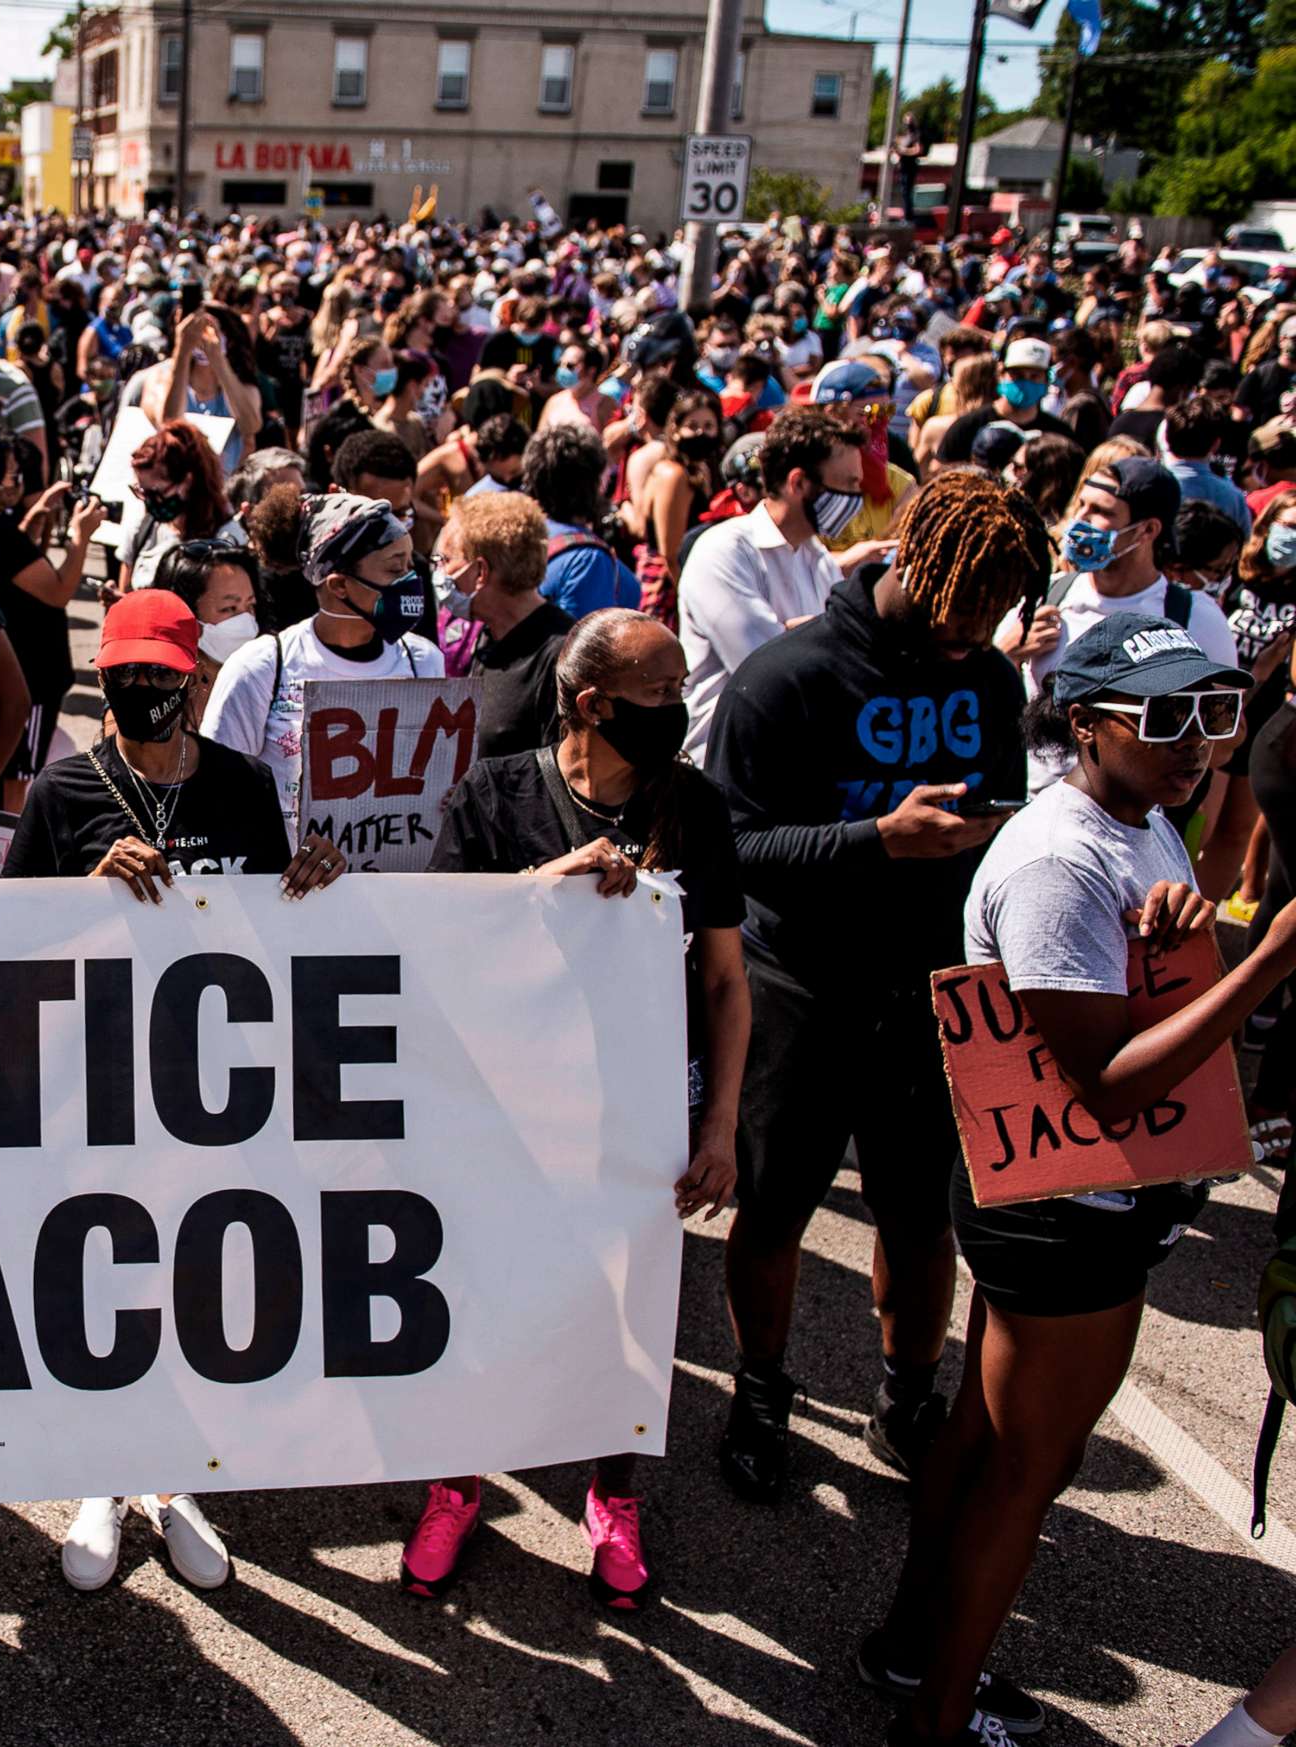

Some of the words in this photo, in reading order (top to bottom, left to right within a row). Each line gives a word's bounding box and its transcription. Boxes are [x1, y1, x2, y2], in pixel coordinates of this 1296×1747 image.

[216, 143, 246, 170] LA
[689, 142, 747, 159] SPEED
[694, 160, 738, 176] LIMIT
[689, 181, 739, 215] 30
[149, 690, 182, 724] BLACK
[856, 689, 981, 768] GBG
[308, 695, 476, 801] BLM
[305, 814, 434, 855] MATTER
